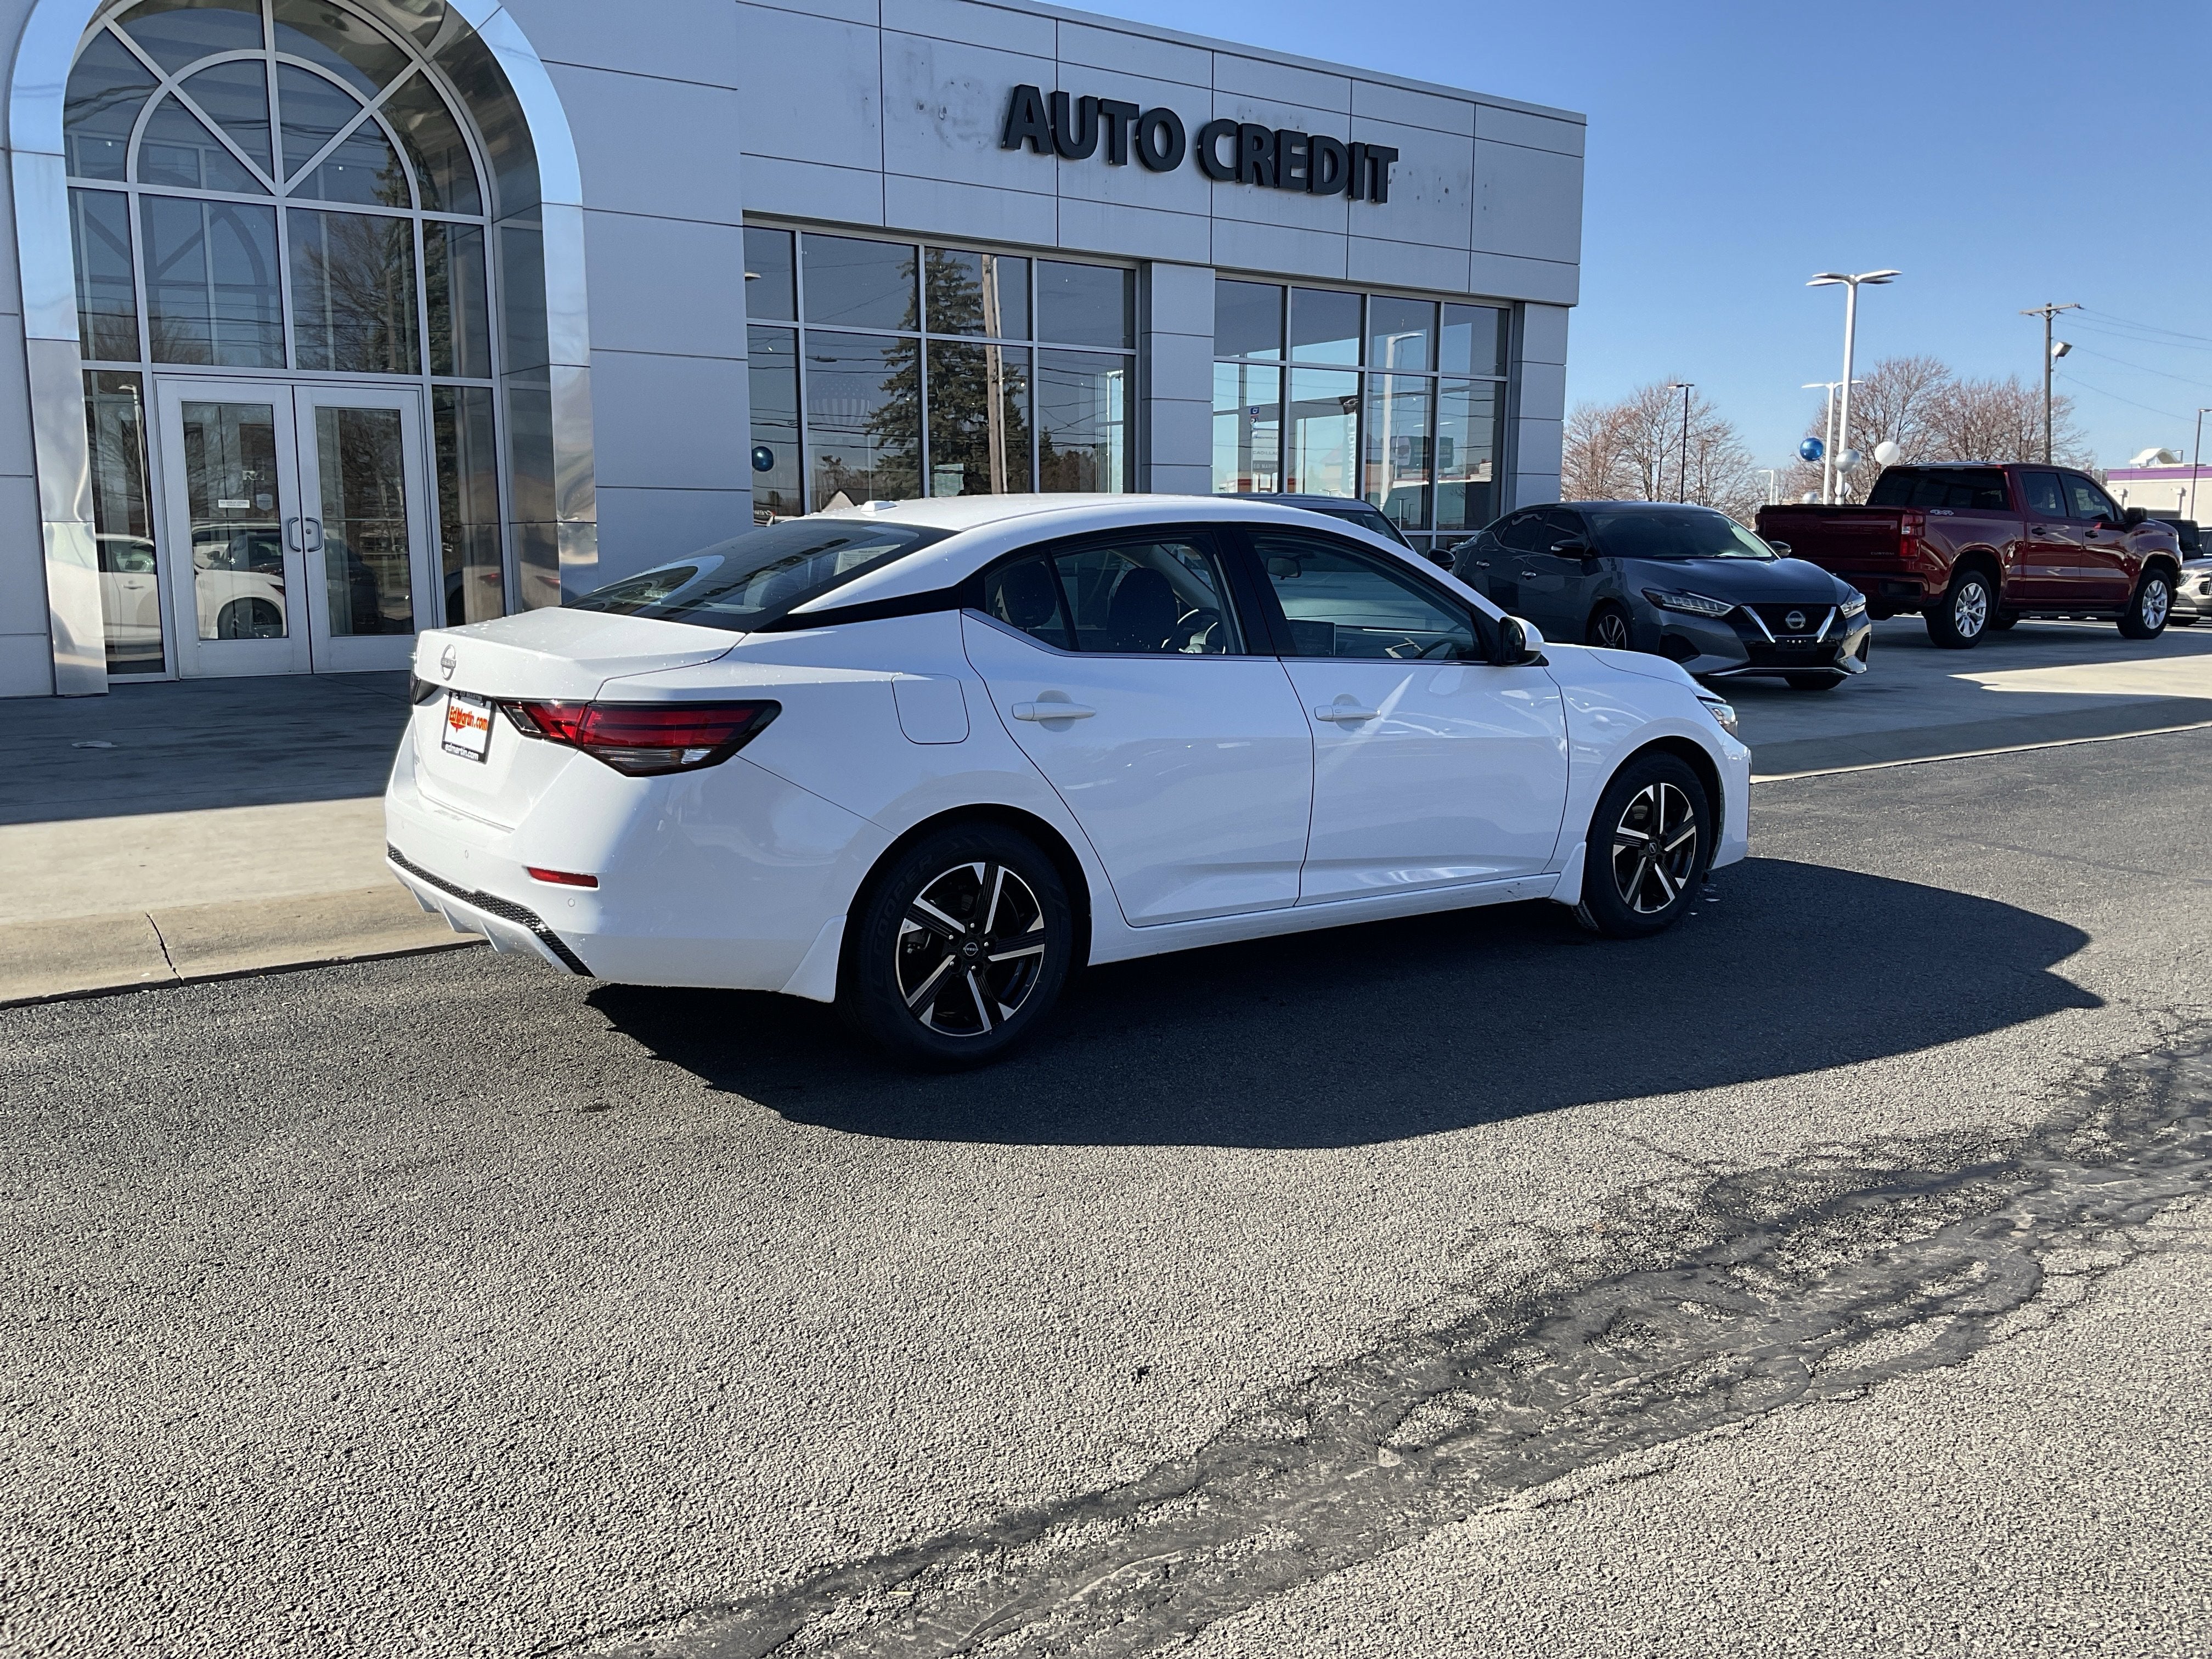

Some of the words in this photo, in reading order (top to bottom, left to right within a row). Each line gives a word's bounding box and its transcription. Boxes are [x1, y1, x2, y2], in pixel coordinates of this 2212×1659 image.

[1001, 84, 1186, 173] AUTO
[1197, 119, 1399, 204] CREDIT
[445, 742, 479, 760] edmartin.com
[873, 854, 933, 956] COOPER
